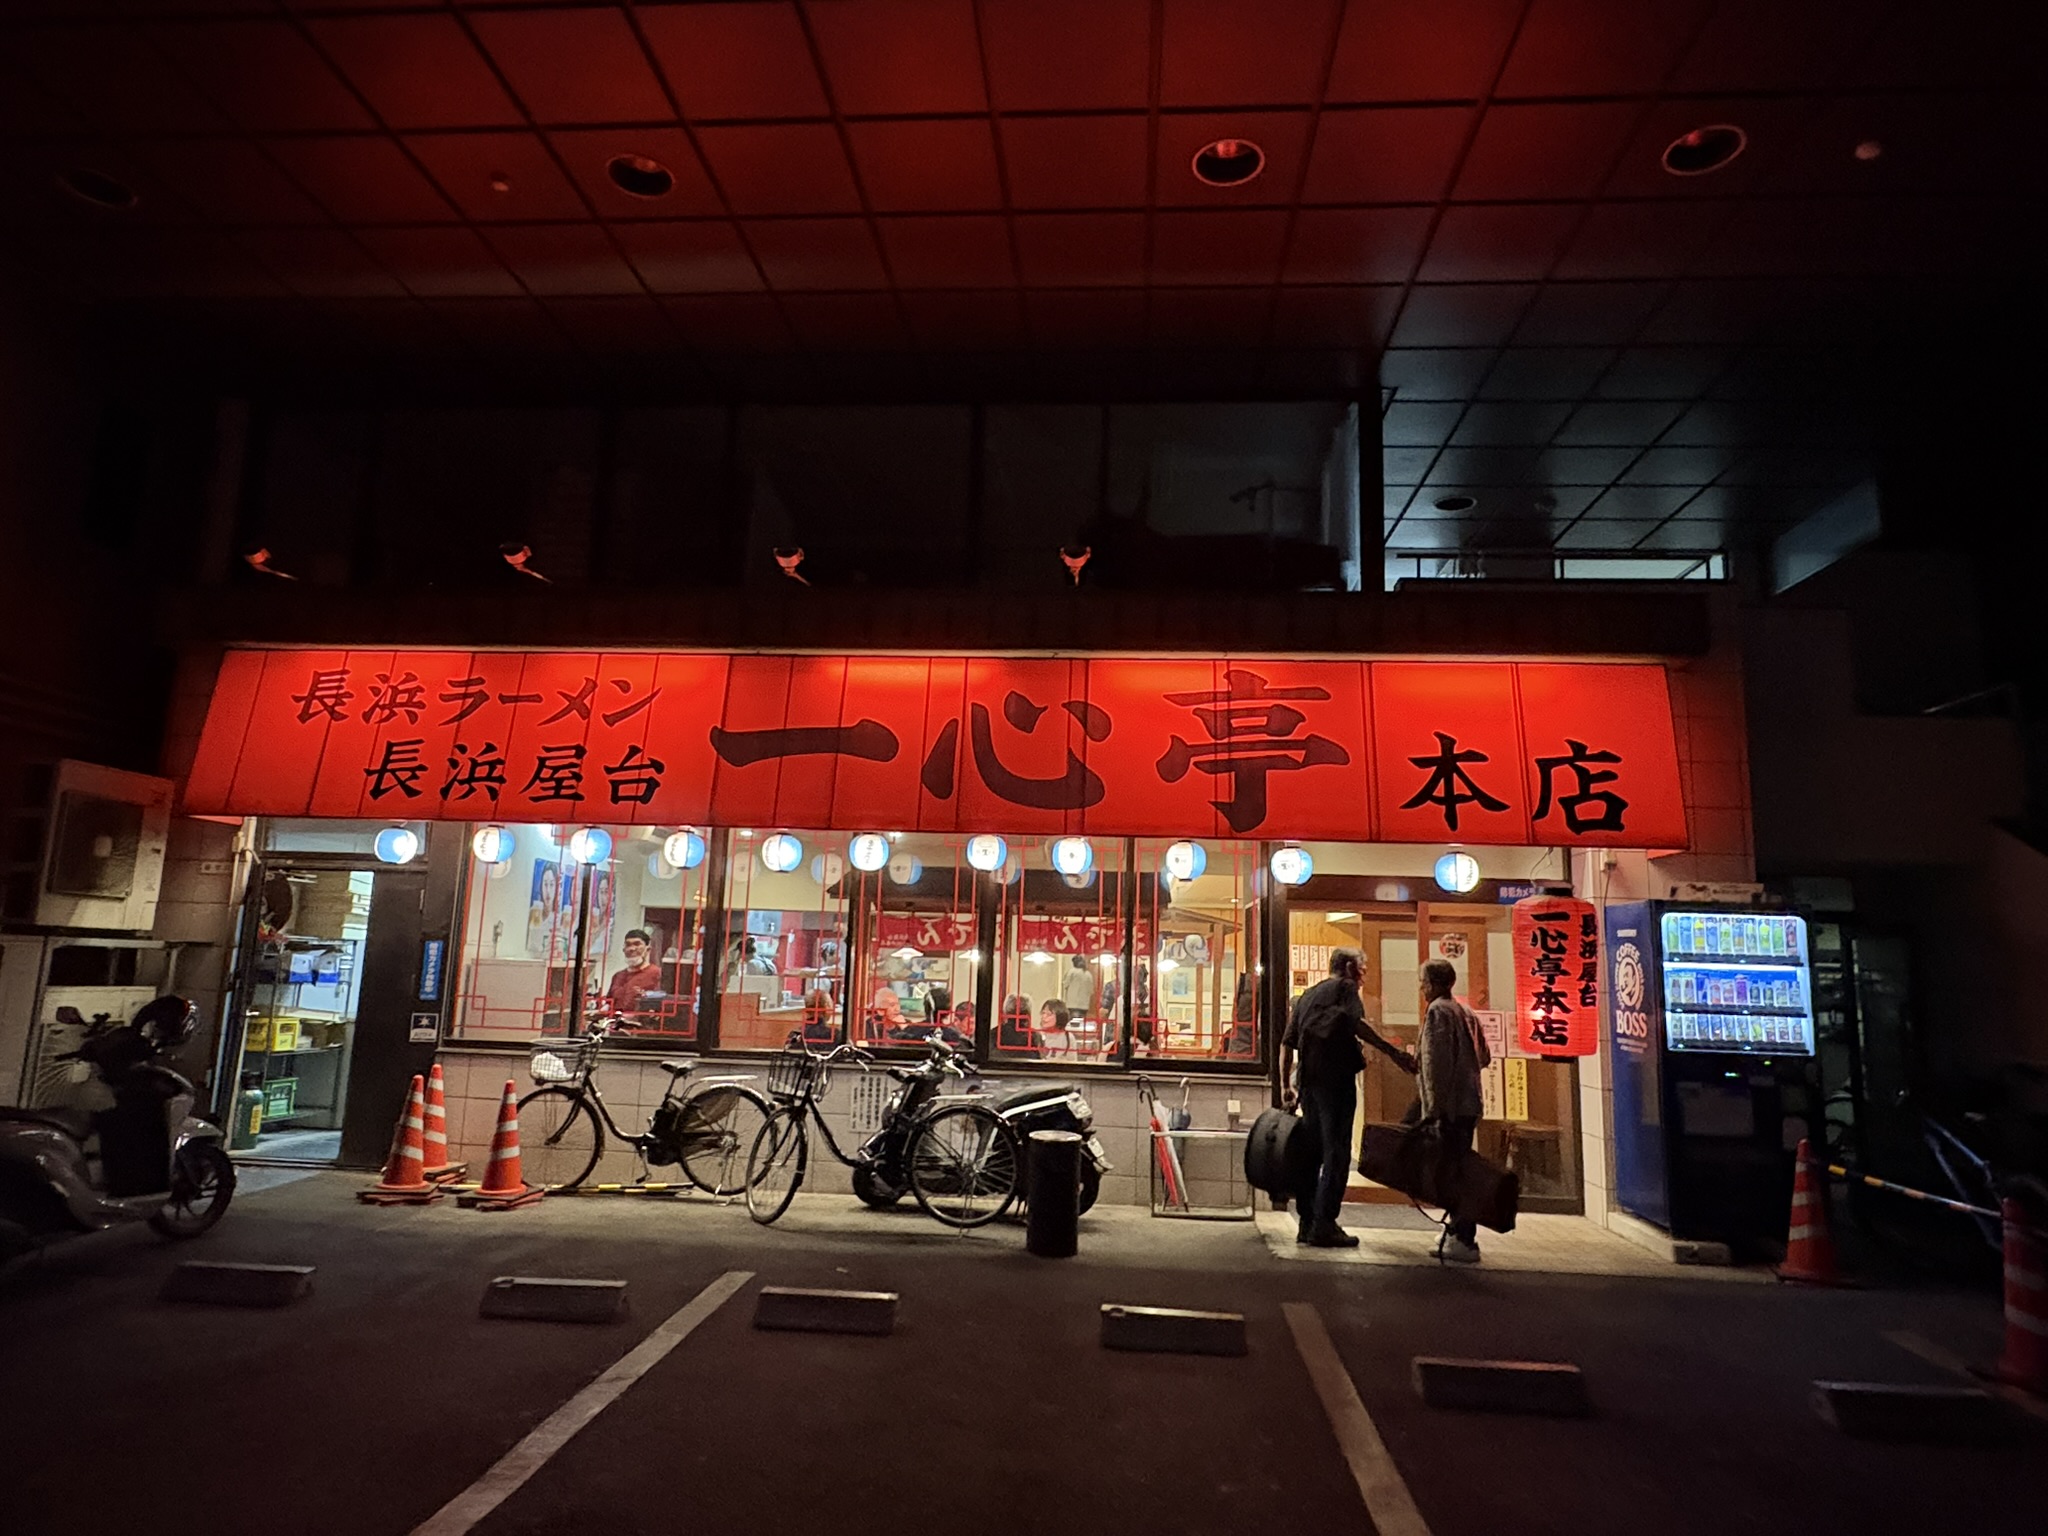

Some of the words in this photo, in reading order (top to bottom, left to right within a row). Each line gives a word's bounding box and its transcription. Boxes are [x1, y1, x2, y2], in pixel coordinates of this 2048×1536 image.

[291, 668, 663, 727] 長浜ラーメン
[363, 739, 666, 804] 長浜屋台
[710, 669, 1351, 834] 一心亭
[1400, 731, 1629, 836] 本店
[1529, 911, 1573, 1047] 一心亭本店
[1616, 942, 1640, 963] COFFEE
[1616, 1010, 1648, 1038] BOSS
